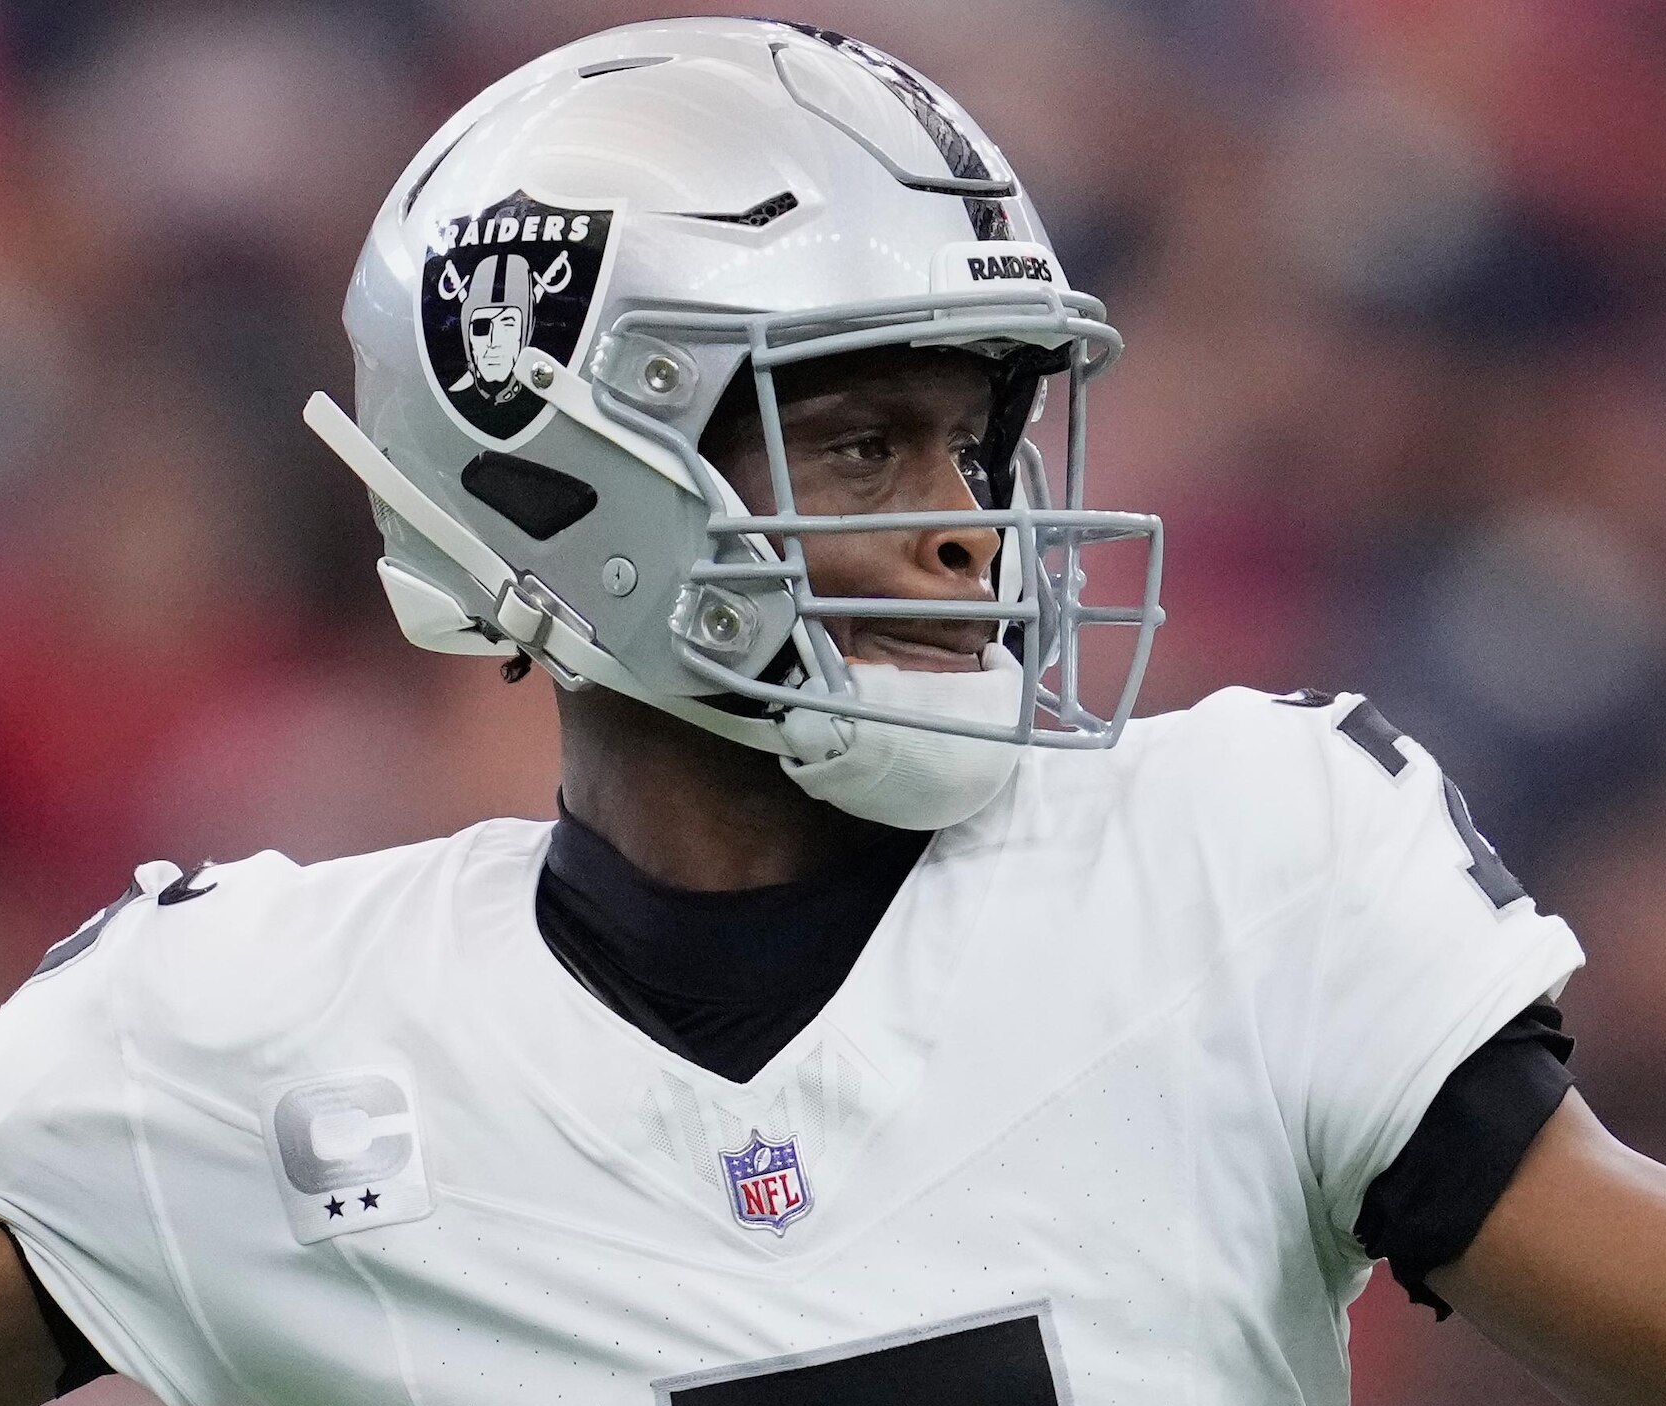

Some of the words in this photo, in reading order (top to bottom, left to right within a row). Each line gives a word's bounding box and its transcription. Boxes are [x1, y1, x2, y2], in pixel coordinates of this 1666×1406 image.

[444, 215, 591, 249] RAIDERS
[967, 255, 1053, 282] RAIDERS
[273, 1074, 414, 1197] C
[740, 1173, 801, 1216] NFL
